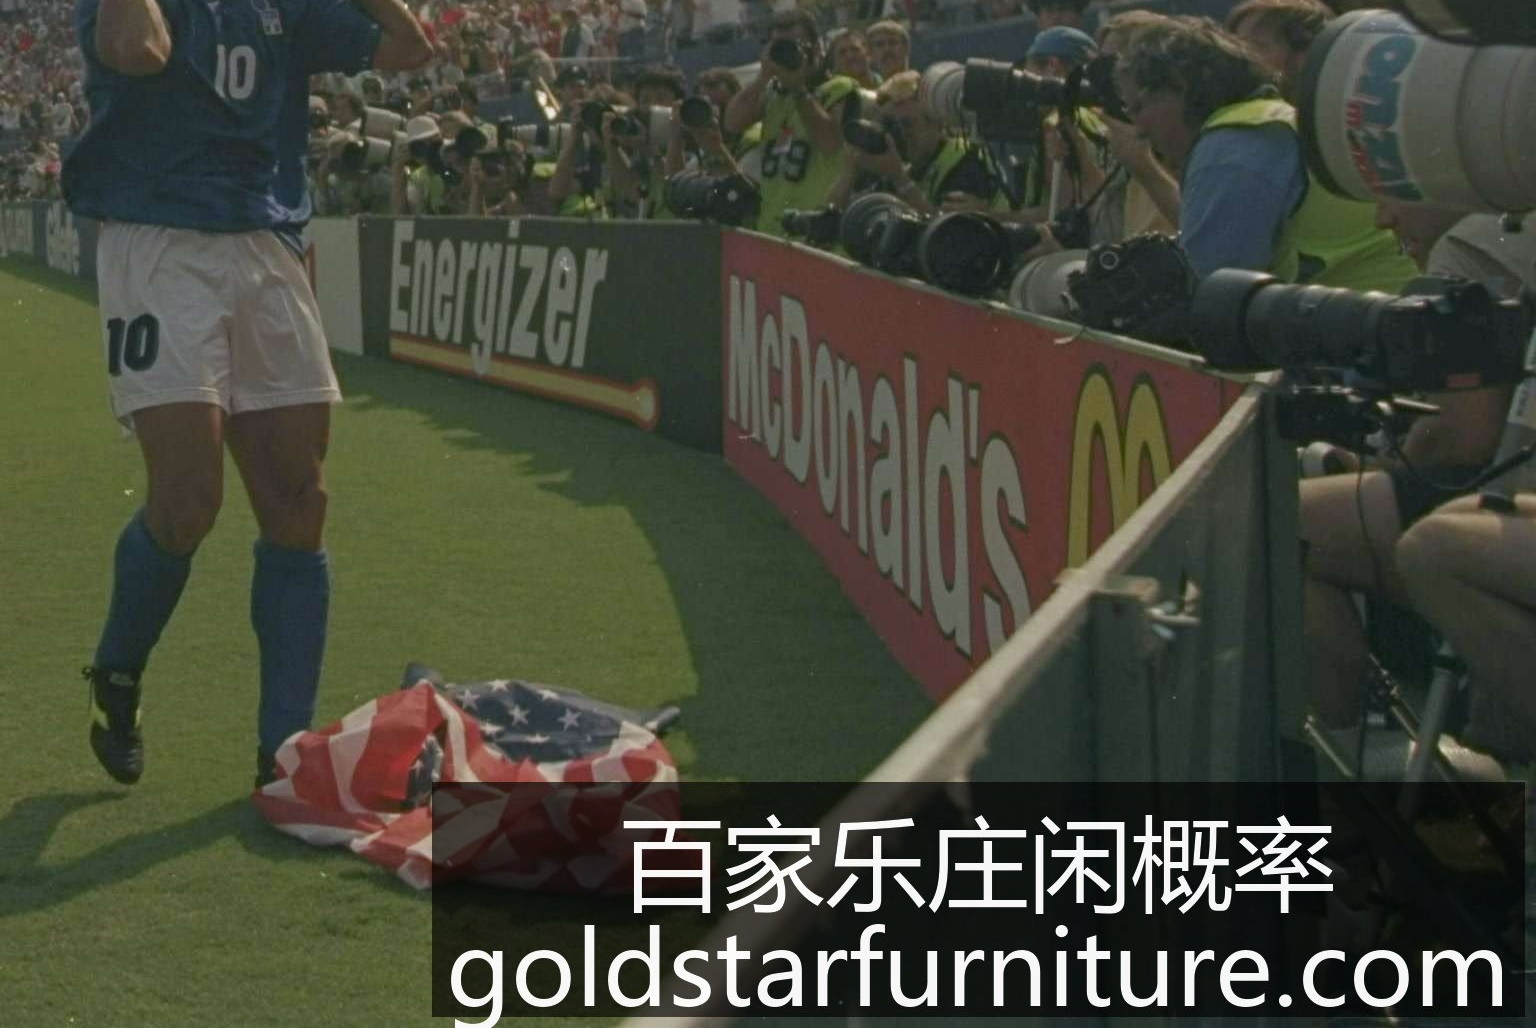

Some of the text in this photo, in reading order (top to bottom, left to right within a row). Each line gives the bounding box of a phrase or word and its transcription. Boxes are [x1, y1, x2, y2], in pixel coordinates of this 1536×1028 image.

[217, 45, 256, 100] 10
[108, 313, 160, 376] 10
[390, 220, 608, 375] Energizer
[728, 275, 1032, 662] McDonald's
